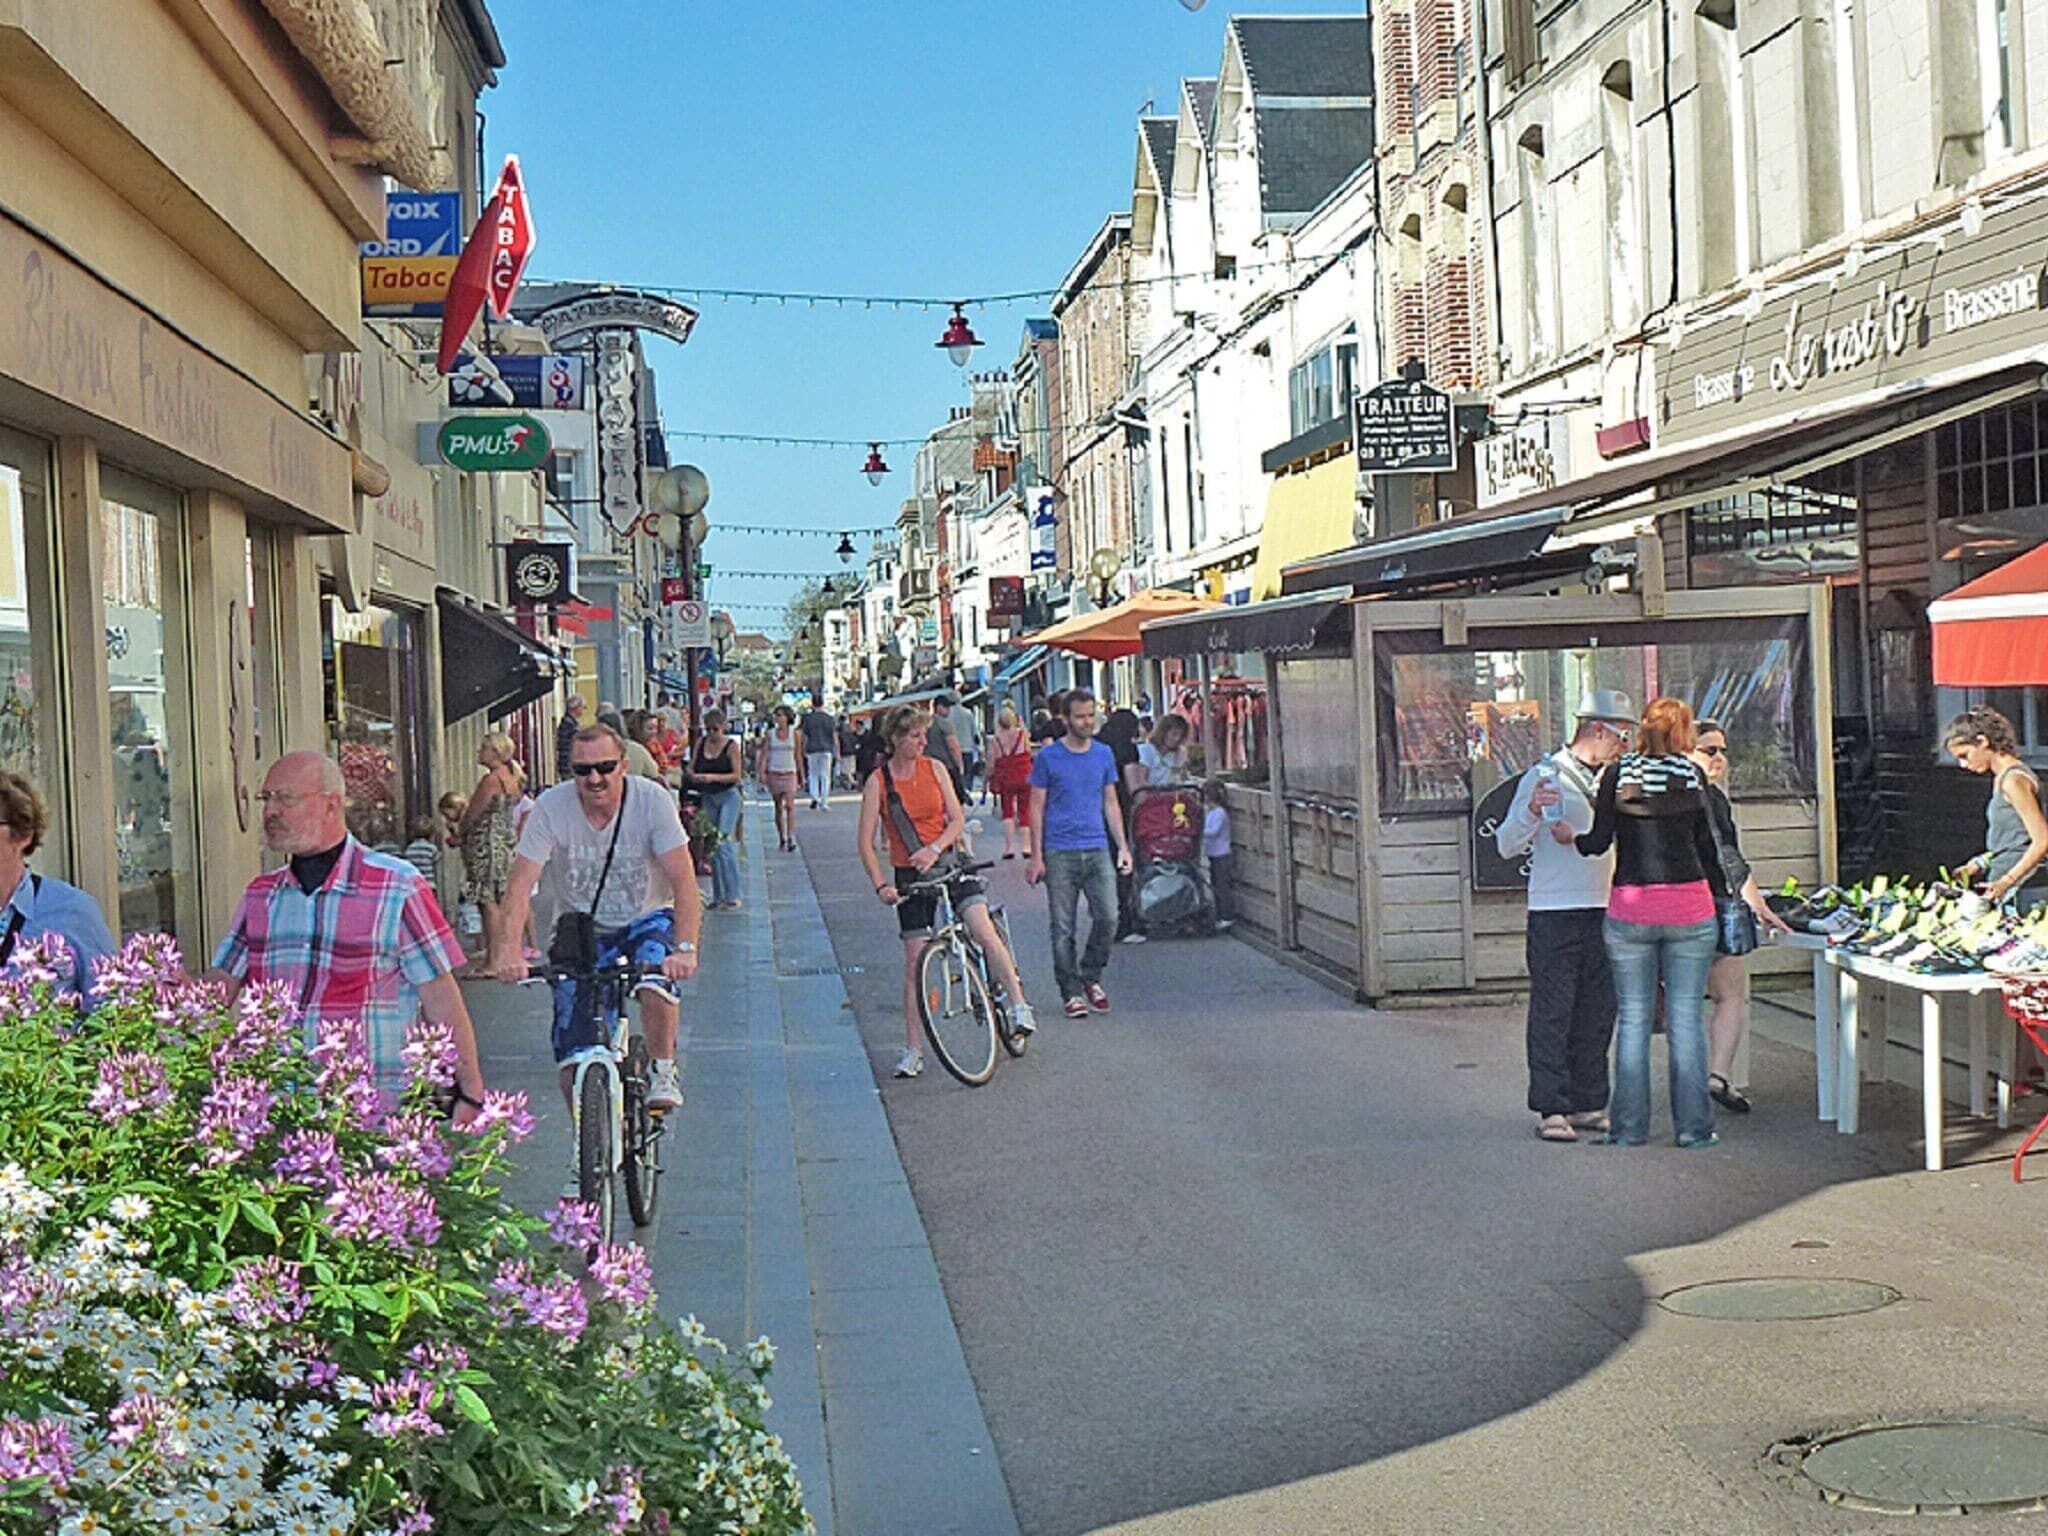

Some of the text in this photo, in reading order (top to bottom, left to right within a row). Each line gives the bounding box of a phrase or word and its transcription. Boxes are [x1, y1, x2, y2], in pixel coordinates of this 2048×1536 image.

[361, 238, 422, 256] ORD
[494, 185, 518, 288] TABAC
[367, 266, 447, 288] Tabac
[1694, 364, 1755, 408] Brassie
[1944, 265, 2038, 332] Brasserie
[1358, 395, 1448, 415] TRAITEUR
[448, 435, 502, 455] PMU
